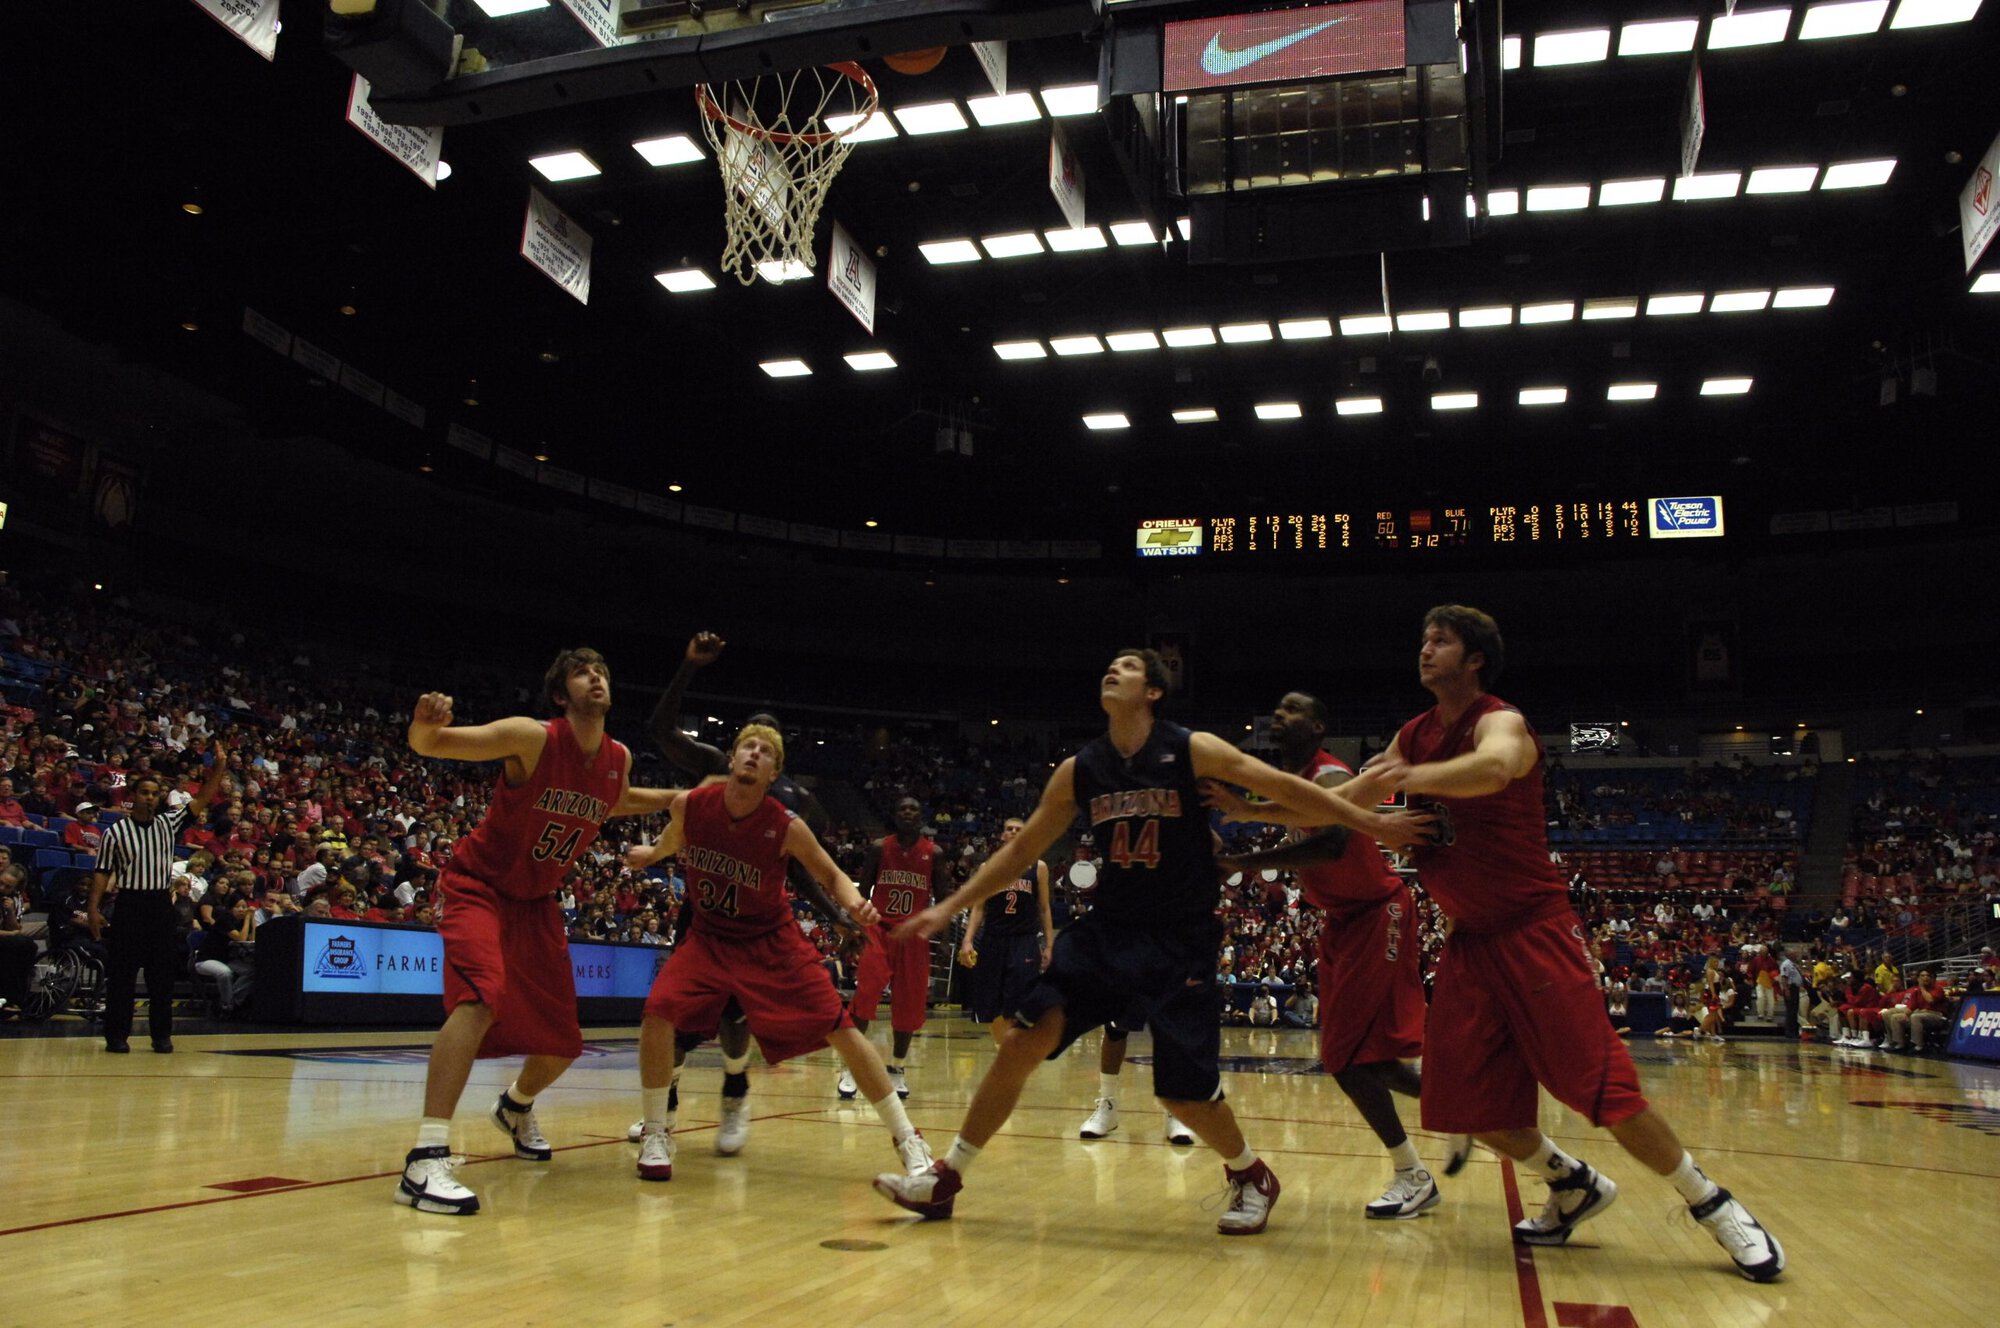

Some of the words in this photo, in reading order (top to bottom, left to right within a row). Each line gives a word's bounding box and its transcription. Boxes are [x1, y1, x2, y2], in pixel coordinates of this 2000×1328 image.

[383, 136, 399, 152] 2000
[1490, 506, 1516, 516] PLYR
[1531, 506, 1539, 514] 0
[1555, 504, 1563, 513] 2
[1622, 502, 1637, 510] 44
[1670, 502, 1703, 510] Tucson
[1376, 512, 1392, 520] RED
[1445, 508, 1466, 517] BLUE
[1674, 508, 1710, 517] Electric
[1142, 519, 1197, 528] O'RIELLY
[1211, 518, 1235, 527] PLYR
[1250, 517, 1257, 525] 5
[1288, 515, 1303, 524] 20
[1335, 514, 1349, 523] 50
[1494, 515, 1513, 524] PTS
[1524, 514, 1539, 523] 25
[1678, 517, 1711, 525] Power
[1215, 526, 1232, 535] PTS
[1377, 522, 1394, 534] 60
[1494, 523, 1515, 532] RBS
[1213, 534, 1234, 543] RBS
[1494, 532, 1516, 541] FLS
[1142, 546, 1197, 556] WATSON
[1250, 542, 1257, 550] 2
[533, 788, 608, 825] ARIZONA
[1090, 788, 1184, 827] ARIZONA
[532, 821, 584, 867] 54
[1109, 819, 1162, 869] 44
[682, 845, 761, 891] ARIZONA
[879, 869, 928, 890] ARIZONA
[698, 879, 740, 918] 34
[885, 888, 914, 915] 20
[1005, 891, 1018, 915] 2
[1385, 902, 1402, 961] CATS
